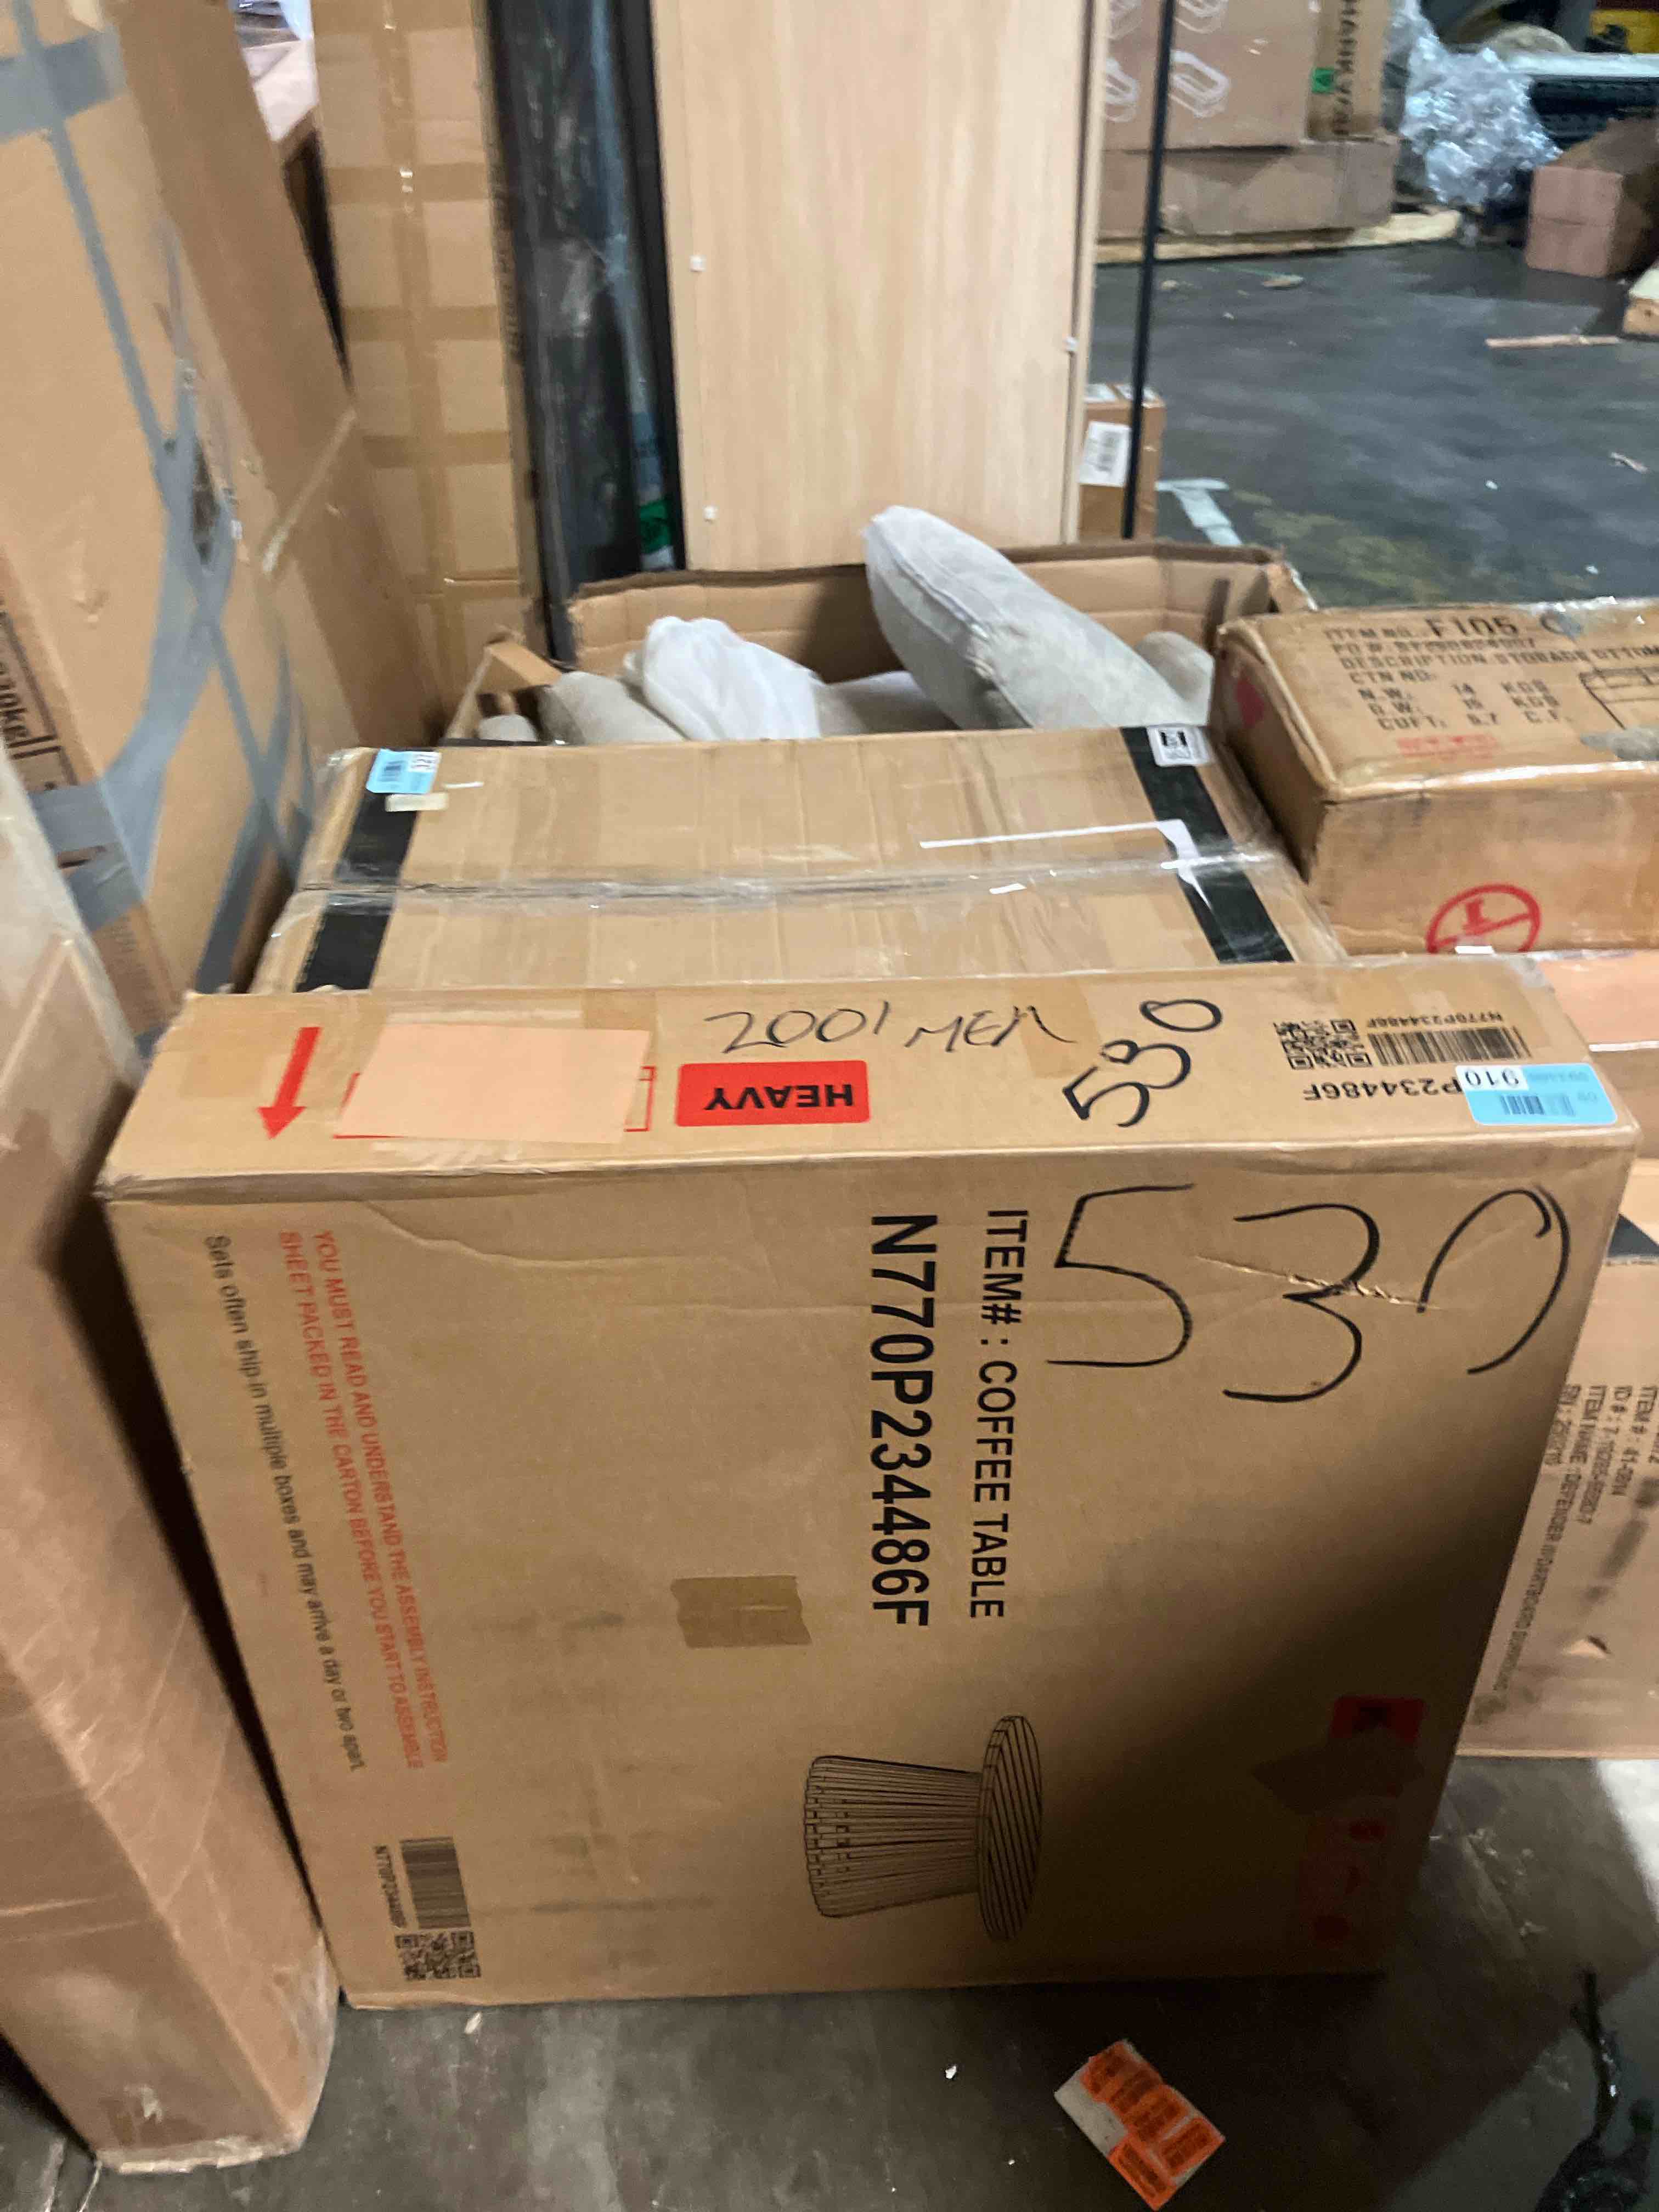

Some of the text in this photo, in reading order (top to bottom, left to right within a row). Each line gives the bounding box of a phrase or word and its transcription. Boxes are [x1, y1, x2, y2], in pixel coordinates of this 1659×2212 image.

[1425, 617, 1520, 637] F105
[1348, 670, 1394, 685] CTN
[1062, 998, 1223, 1127] 530
[1464, 1066, 1520, 1088] 910
[704, 1084, 854, 1110] HEAVY
[204, 1235, 235, 1279] Sets
[280, 1231, 317, 1296] SHEET
[314, 1229, 341, 1272] YOU
[981, 1210, 1029, 1325] ITEM#
[218, 1285, 249, 1334] often
[325, 1279, 355, 1328] MUST
[1045, 1181, 1571, 1402] 530
[234, 1340, 263, 1377] ship
[298, 1302, 333, 1378] PACKED
[339, 1336, 368, 1387] READ
[247, 1382, 269, 1399] in
[317, 1383, 339, 1401] IN
[352, 1391, 379, 1427] AND
[254, 1404, 289, 1469] multiple
[322, 1404, 350, 1440] THE
[870, 1215, 939, 1626] N770P234486F
[974, 1361, 1018, 1502] COFFEE
[273, 1475, 301, 1524] boxes
[331, 1443, 363, 1514] CARTON
[360, 1433, 404, 1546] UNDERSTAND
[288, 1530, 312, 1558] and
[349, 1518, 381, 1581] BEFORE
[388, 1549, 410, 1580] THE
[297, 1563, 318, 1595] may
[970, 1513, 1008, 1618] TABLE
[307, 1600, 333, 1642] arrive
[366, 1588, 388, 1618] YOU
[318, 1646, 335, 1655] a
[323, 1660, 342, 1685] day
[388, 1672, 407, 1694] TO
[331, 1689, 348, 1702] or
